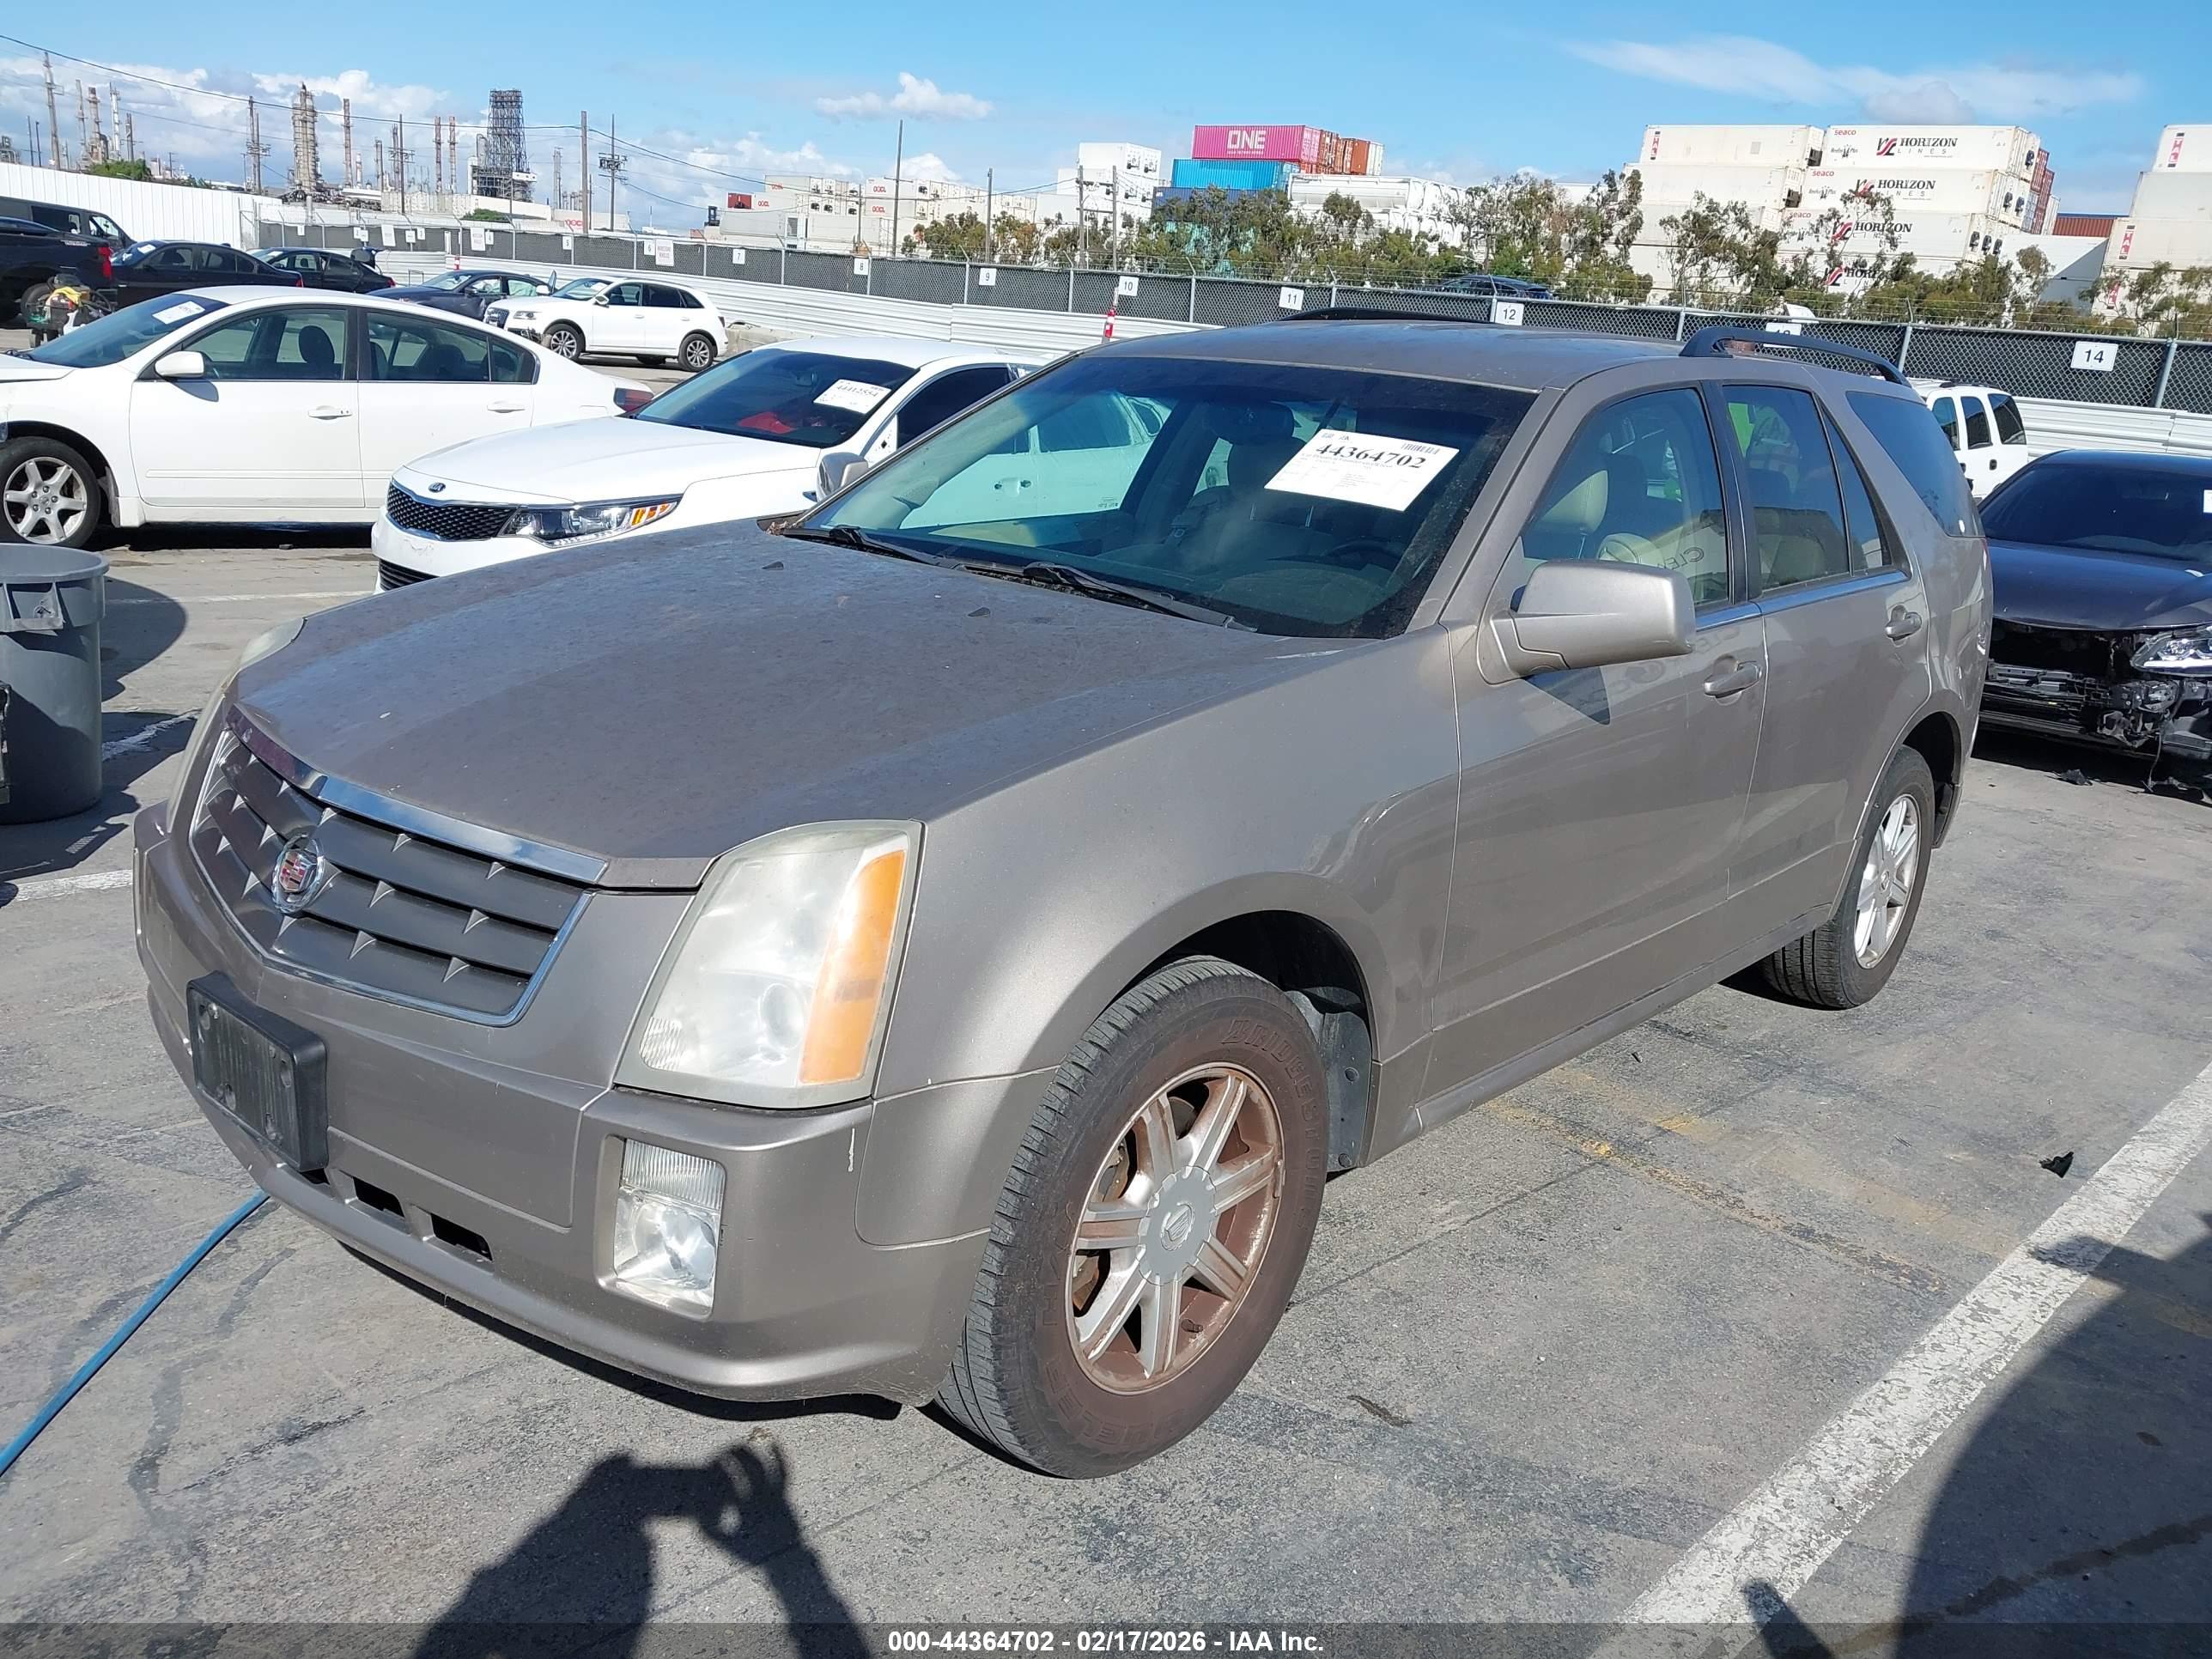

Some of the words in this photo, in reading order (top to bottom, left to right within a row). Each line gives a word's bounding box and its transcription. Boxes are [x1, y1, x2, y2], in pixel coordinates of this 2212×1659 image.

[1227, 130, 1267, 149] ONE
[1899, 137, 1958, 147] HORIZON
[1878, 179, 1936, 190] HORIZON
[737, 252, 741, 261] 7
[860, 263, 865, 271] 8
[985, 272, 990, 281] 9
[1123, 281, 1133, 292] 10
[1287, 294, 1297, 304] 11
[1503, 309, 1516, 320] 12
[2085, 349, 2104, 363] 14
[1316, 443, 1427, 469] 44364702
